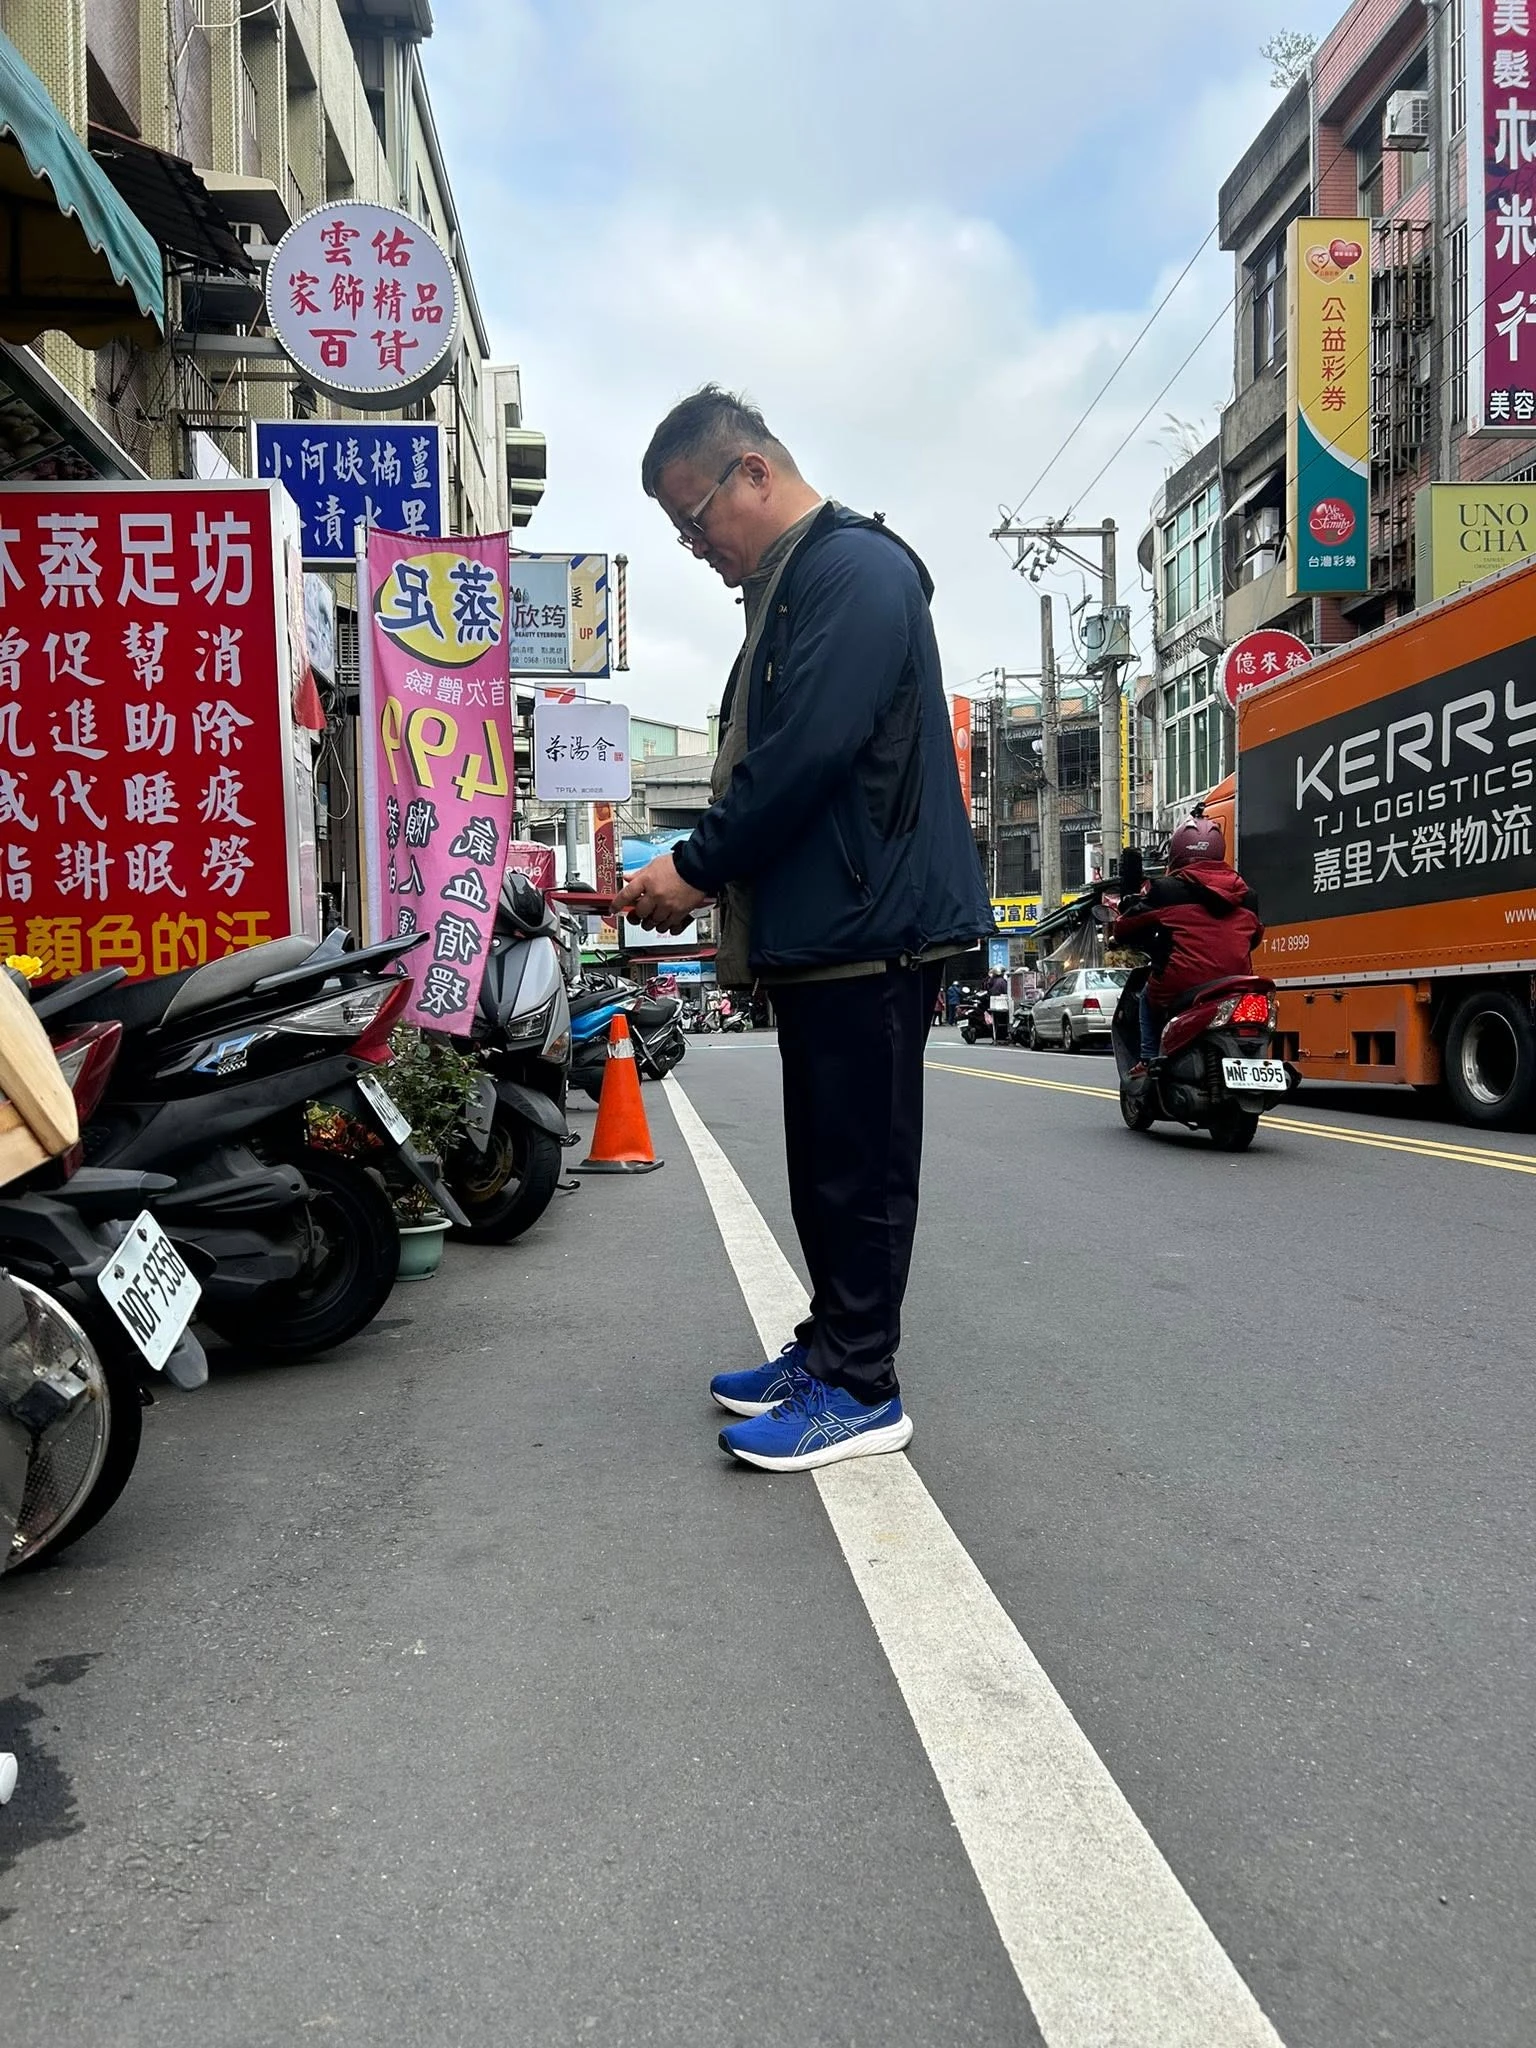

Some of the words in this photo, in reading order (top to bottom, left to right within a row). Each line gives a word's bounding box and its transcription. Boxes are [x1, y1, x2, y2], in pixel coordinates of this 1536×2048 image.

[320, 220, 415, 268] 雲佑
[288, 270, 444, 325] 家飾精品
[308, 328, 420, 376] 百貨
[1321, 297, 1347, 412] 公益彩券
[300, 494, 431, 551] 漬水果
[1317, 503, 1340, 515] We
[1458, 502, 1529, 527] UNO
[1308, 555, 1357, 568] 台灣彩券
[1459, 529, 1528, 553] CHA
[579, 627, 593, 640] UP
[41, 630, 115, 902] 促進代謝
[122, 620, 187, 900] 幫助睡眠
[192, 624, 257, 898] 消除疲勞
[545, 734, 616, 762] 茶湯會
[1313, 809, 1345, 838] TJ
[1355, 758, 1534, 829] LOGISTICS
[505, 863, 542, 881] anda
[1313, 803, 1535, 894] 嘉里大榮物流
[1262, 938, 1268, 954] T
[1271, 936, 1286, 953] 412
[1287, 934, 1310, 951] 8999
[117, 1235, 187, 1347] NDF-9358
